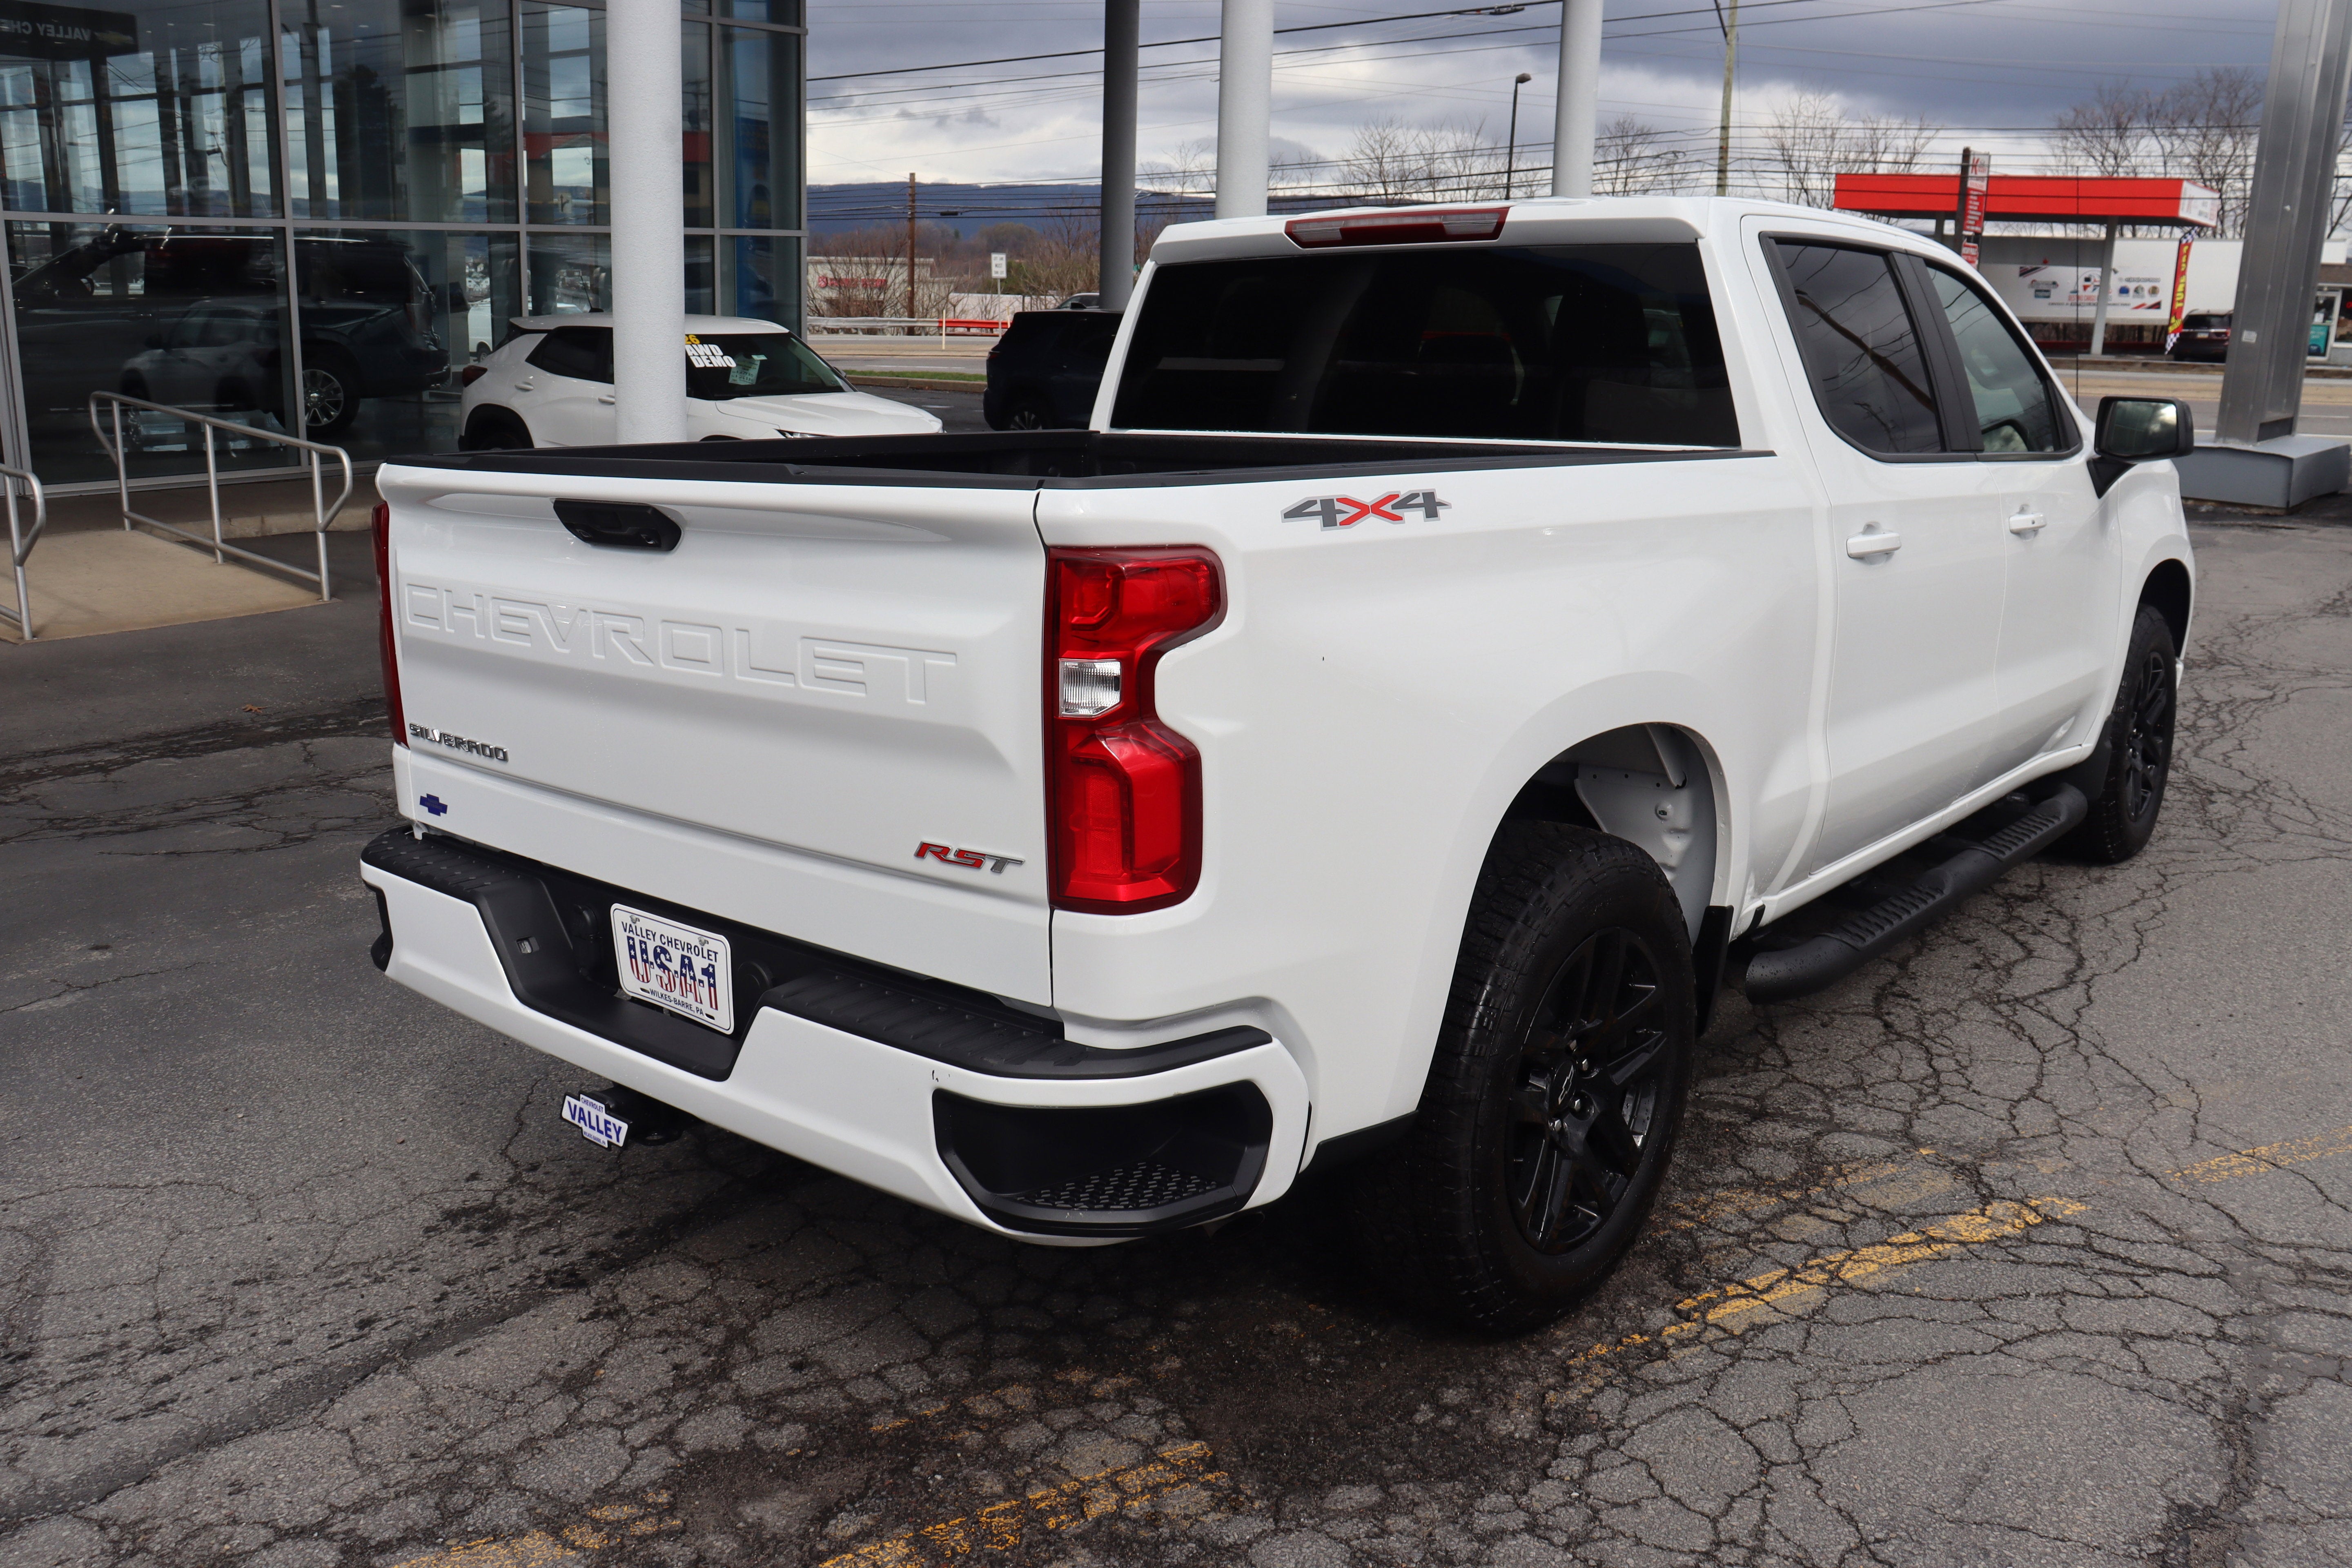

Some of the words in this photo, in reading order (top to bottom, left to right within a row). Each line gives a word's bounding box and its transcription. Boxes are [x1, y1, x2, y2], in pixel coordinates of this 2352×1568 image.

[2175, 274, 2187, 310] TUNE
[685, 344, 724, 356] AWD
[690, 355, 737, 368] DEMO
[405, 583, 957, 705] CHEVROLET
[410, 722, 508, 762] SILVERADO
[913, 840, 1025, 873] RST
[621, 921, 657, 942] VALLEY
[659, 933, 719, 963] CHEVROLET
[650, 988, 695, 1013] WILKES-BARRE,
[696, 1007, 704, 1016] PA
[567, 1100, 622, 1143] VALLEY
[581, 1097, 604, 1113] CHEVROLET
